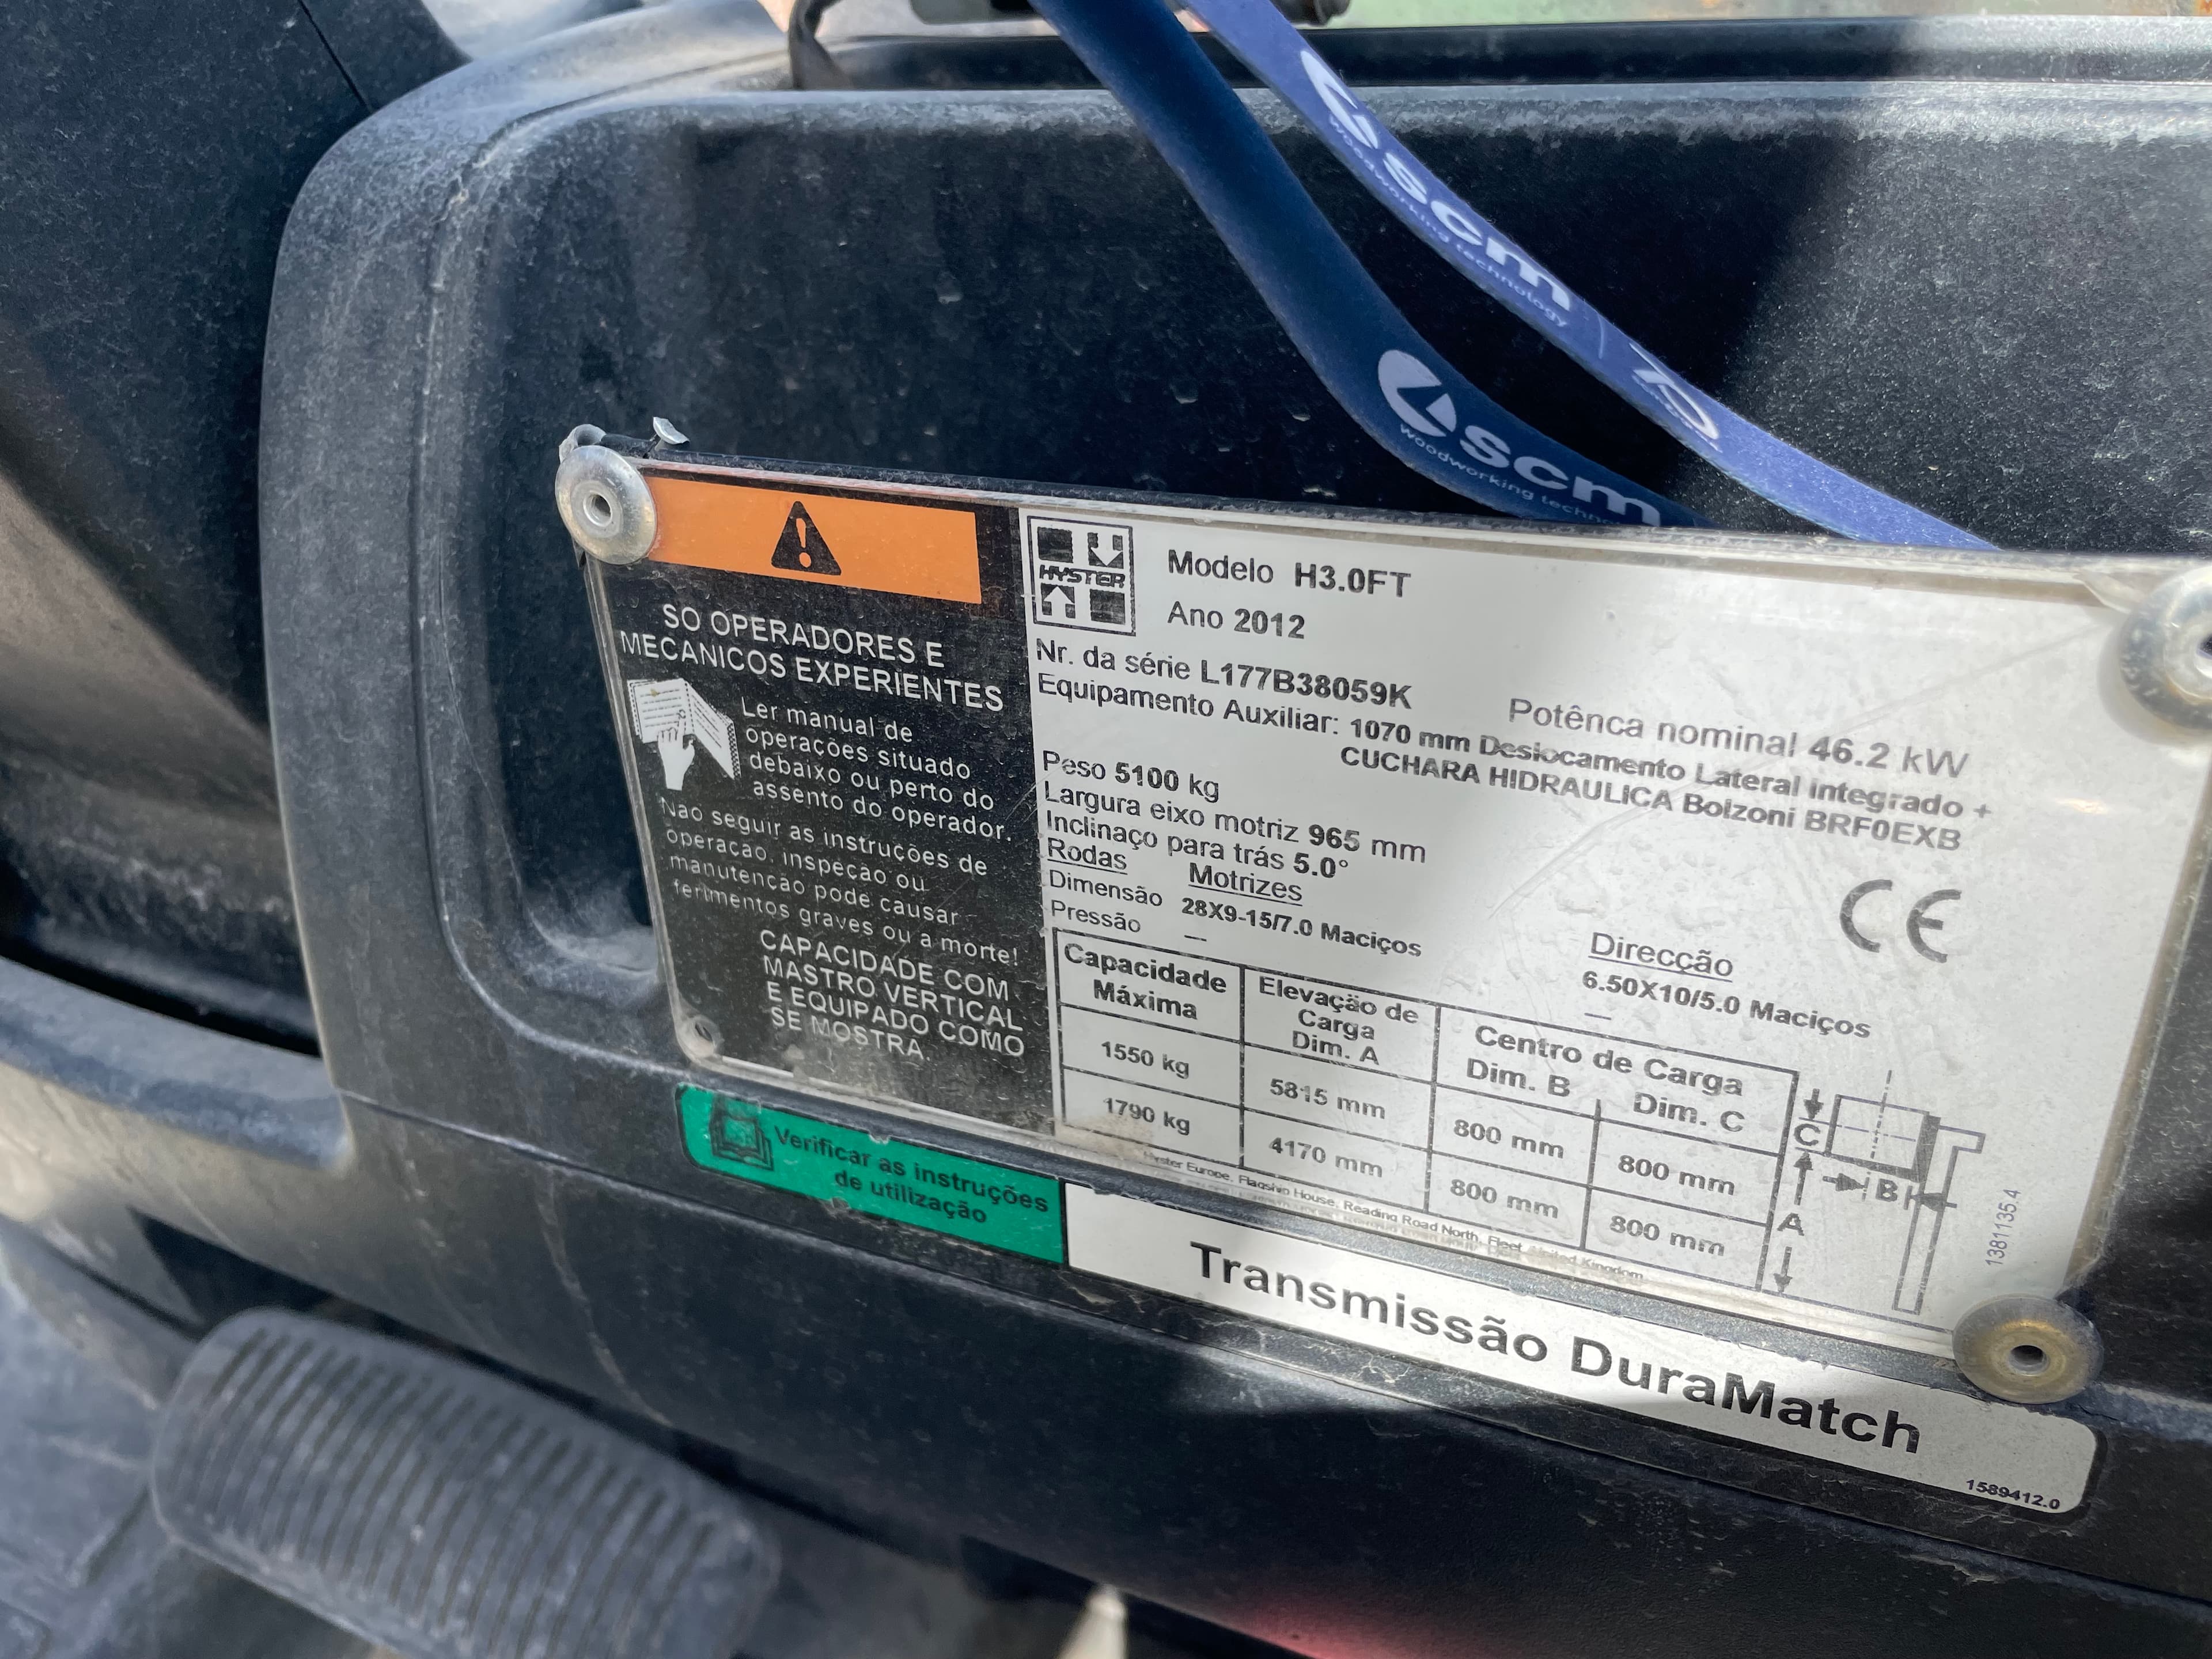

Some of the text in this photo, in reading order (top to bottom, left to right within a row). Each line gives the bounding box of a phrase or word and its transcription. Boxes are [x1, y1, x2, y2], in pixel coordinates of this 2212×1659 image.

[1400, 423, 1534, 500] woodworking
[1460, 425, 1660, 527] scm
[1039, 564, 1126, 589] HYSTER
[1168, 549, 1411, 597] Modelo H3.0FT
[663, 604, 945, 668] SO OPERADORES E
[1168, 601, 1305, 639] Ano 2012
[620, 630, 1003, 712] MECANICOS EXPERIENTES
[1036, 638, 1412, 709] Nr. da série L177B38059K
[741, 696, 912, 743] Ler manual de
[1038, 673, 1214, 717] Equipamento
[1223, 699, 1339, 735] Auxiliar:
[1350, 718, 1411, 744] 1070
[1419, 732, 1471, 753] mm
[1695, 762, 1801, 797] Lateral
[746, 728, 971, 779] operações situado
[1657, 722, 1797, 757] nominal
[1808, 736, 1889, 770] 46.2
[1902, 745, 1969, 778] kW
[750, 751, 994, 810] debaixo ou perto do
[1042, 749, 1220, 803] Peso 5100 kg
[1340, 747, 1480, 785] CUCHARA
[1489, 766, 1673, 812] HIDRAULICA
[1683, 793, 1796, 828] Bolzoni
[753, 779, 1012, 840] assento do operador.
[1044, 781, 1427, 864] Largura eixo motriz 965 mm
[711, 810, 781, 836] seguir
[790, 825, 814, 843] as
[824, 827, 949, 869] instruções
[959, 854, 987, 876] de
[1046, 810, 1158, 850] Inclinaço
[1167, 833, 1225, 860] para
[1234, 838, 1285, 871] trás
[896, 873, 925, 892] ou
[1047, 838, 1304, 903] Rodas Motrizes
[673, 878, 1018, 966] ferimentos graves ou a morte!
[815, 884, 870, 908] pode
[880, 897, 958, 925] causar
[1049, 869, 1422, 957] Dimensão 28X9-15/7.0 Maciços
[1051, 899, 1142, 934] Pressão
[760, 929, 1009, 1001] CAPACIDADE COM
[1064, 942, 1228, 994] Capacidade
[1589, 931, 1734, 979] Direcção
[764, 956, 1024, 1031] MASTRO VERTICAL
[1094, 978, 1198, 1020] Máxima
[1384, 1002, 1419, 1024] de
[1581, 970, 1872, 1039] 6.50X10/5.0 Maciços
[767, 982, 1025, 1056] E EQUIPADO COMO
[771, 1007, 802, 1032] SE
[1298, 1008, 1375, 1041] Carga
[1101, 1040, 1191, 1080] 1550 kg
[1292, 1029, 1380, 1066] Dim. A
[1474, 1024, 1744, 1097] Centro de Carga
[1270, 1078, 1386, 1120] 5815 mm
[1466, 1058, 1571, 1097] Dim. B
[1104, 1097, 1191, 1136] 1790 kg
[1633, 1092, 1746, 1134] Dim. C
[1793, 1123, 1821, 1147] C
[1268, 1138, 1384, 1179] 4170 mm
[1453, 1119, 1565, 1160] 800 mm
[774, 1125, 1048, 1212] Verificar as instruções
[1617, 1154, 1736, 1196] 800 mm
[1876, 1178, 1899, 1203] B
[835, 1171, 987, 1223] de utilização
[1450, 1179, 1559, 1219] 800 mm
[1402, 1214, 1438, 1232] Road
[1609, 1215, 1725, 1256] 800 mm
[1777, 1213, 1805, 1237] A
[1985, 1188, 2022, 1267] 1381135.4
[1190, 1240, 1922, 1454] Transmissão DuraMatch
[1965, 1479, 2061, 1510] 1589412.0
